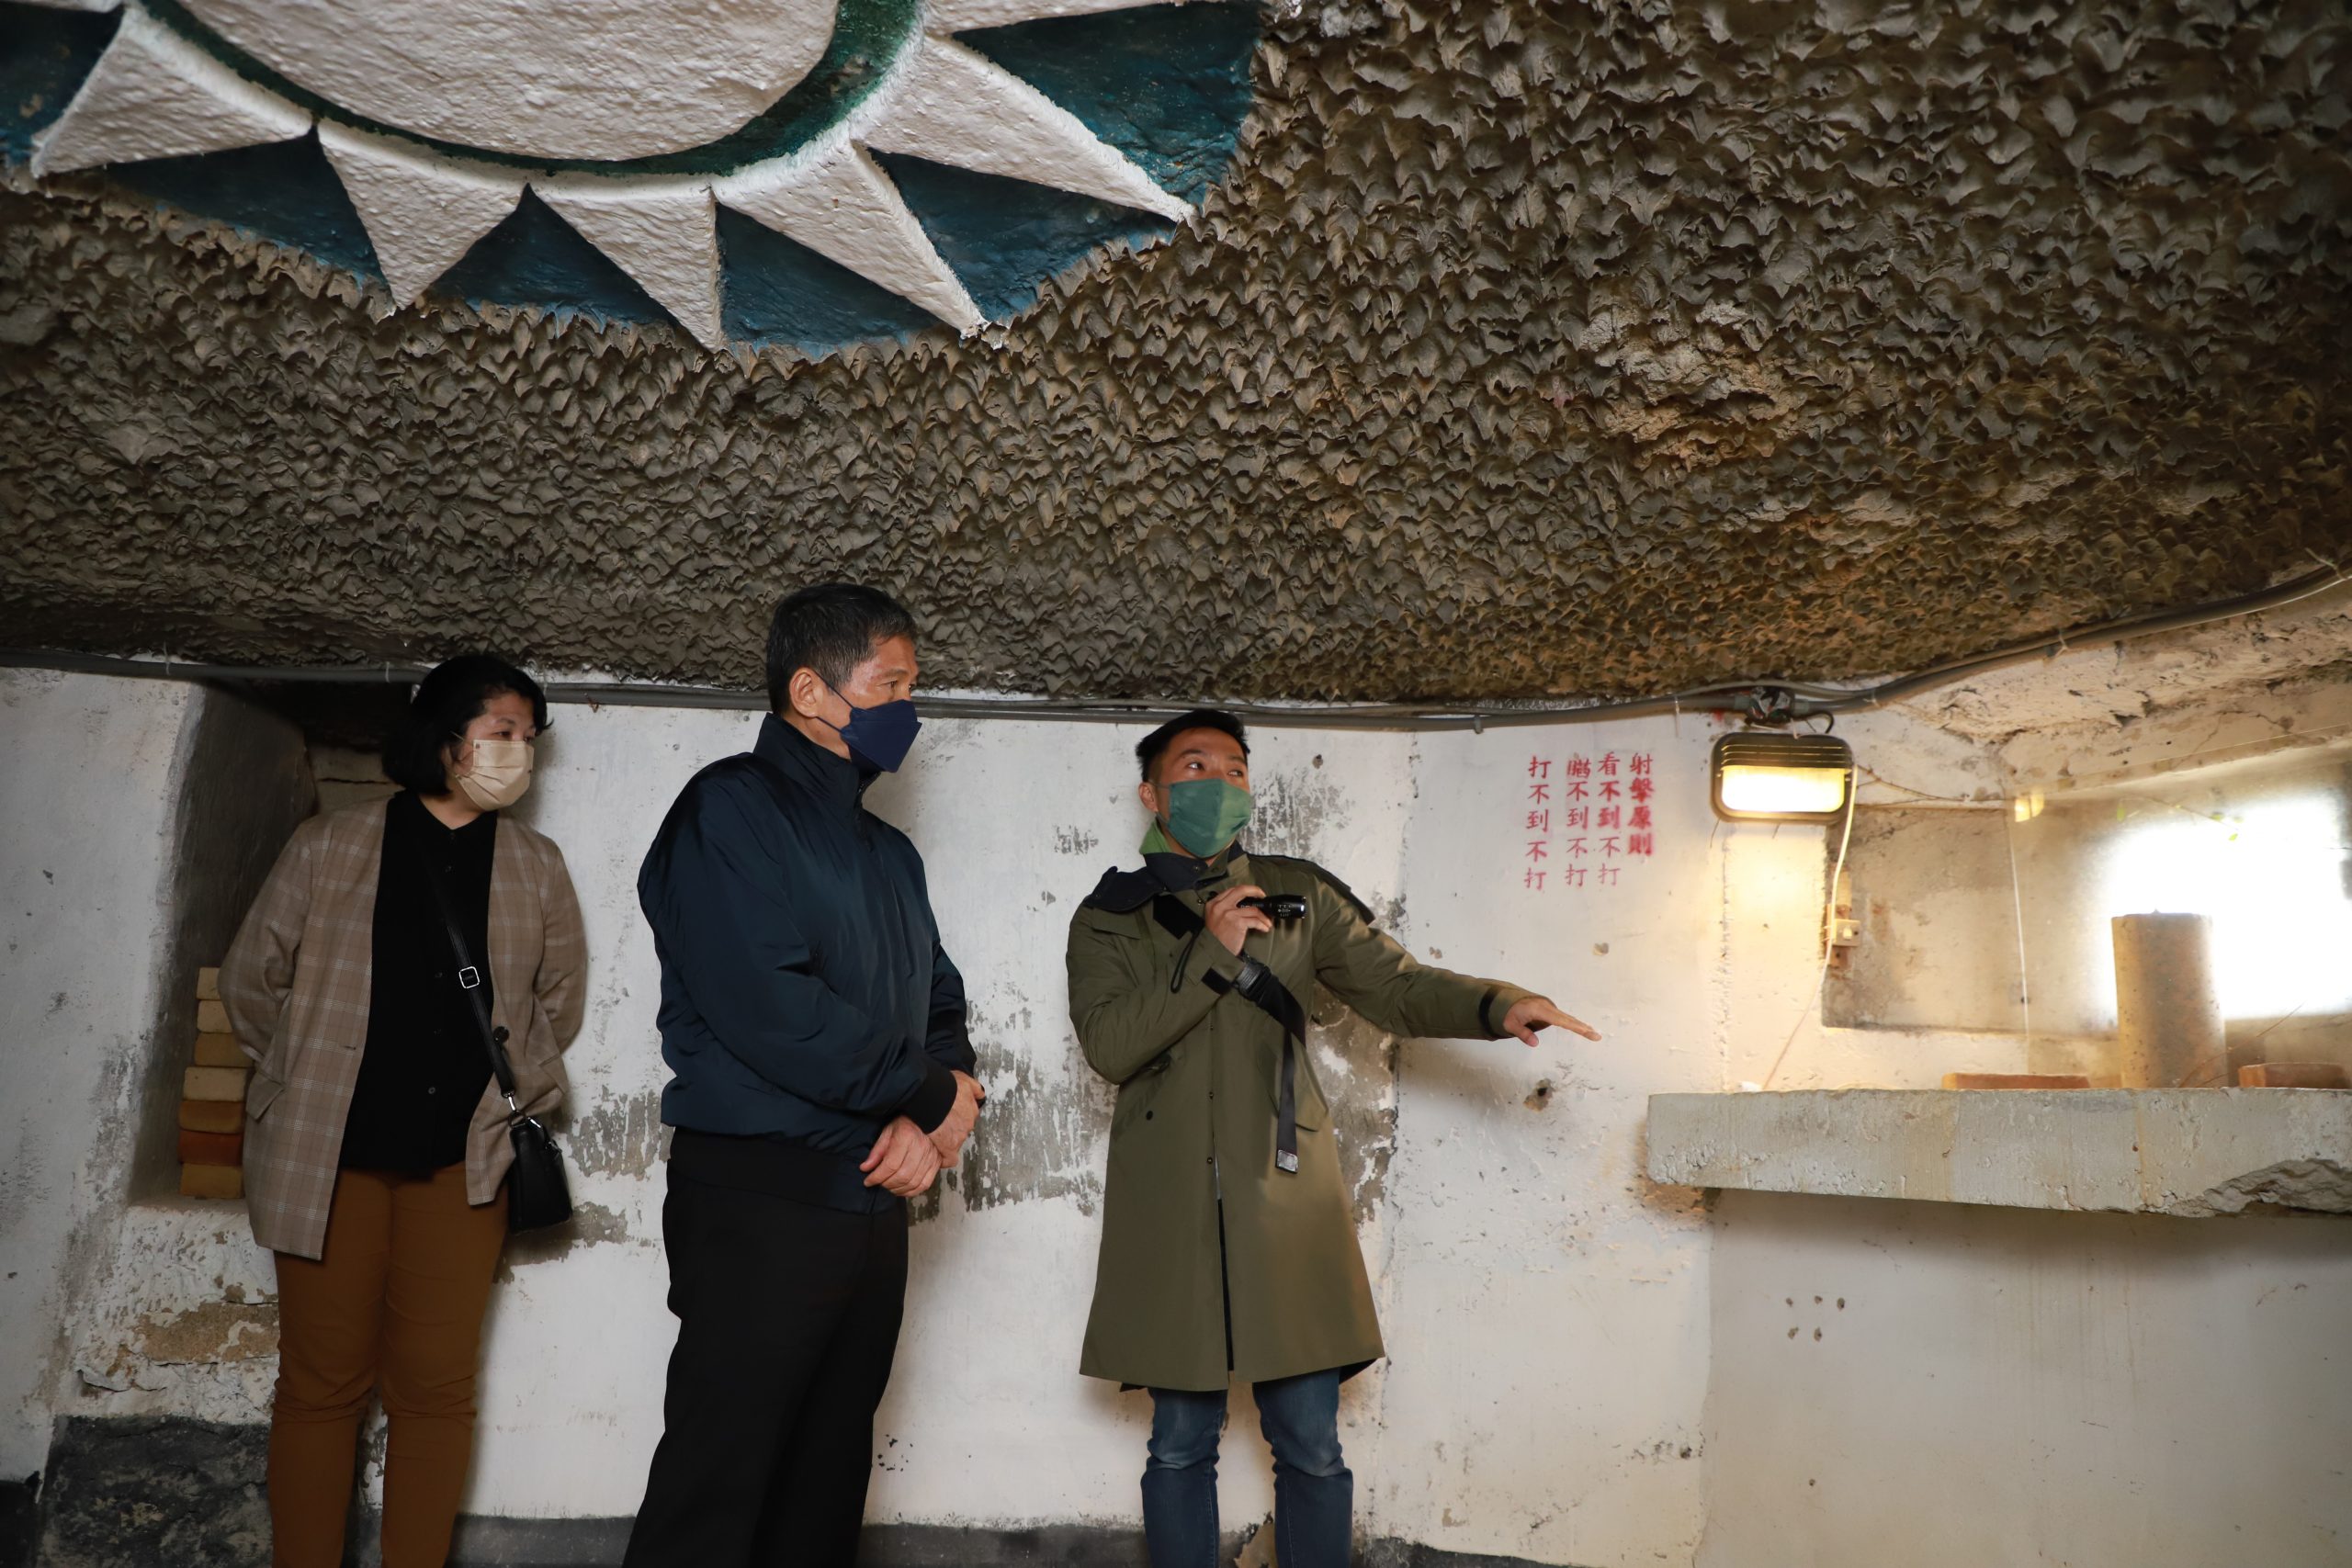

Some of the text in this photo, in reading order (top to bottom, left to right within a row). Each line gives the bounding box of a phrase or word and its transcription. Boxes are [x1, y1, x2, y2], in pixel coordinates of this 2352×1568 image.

[1523, 756, 1552, 891] 打不到不打
[1564, 759, 1592, 887] 瞄不到不打
[1597, 751, 1622, 886] 看不到不打
[1627, 752, 1656, 857] 射擊原則
